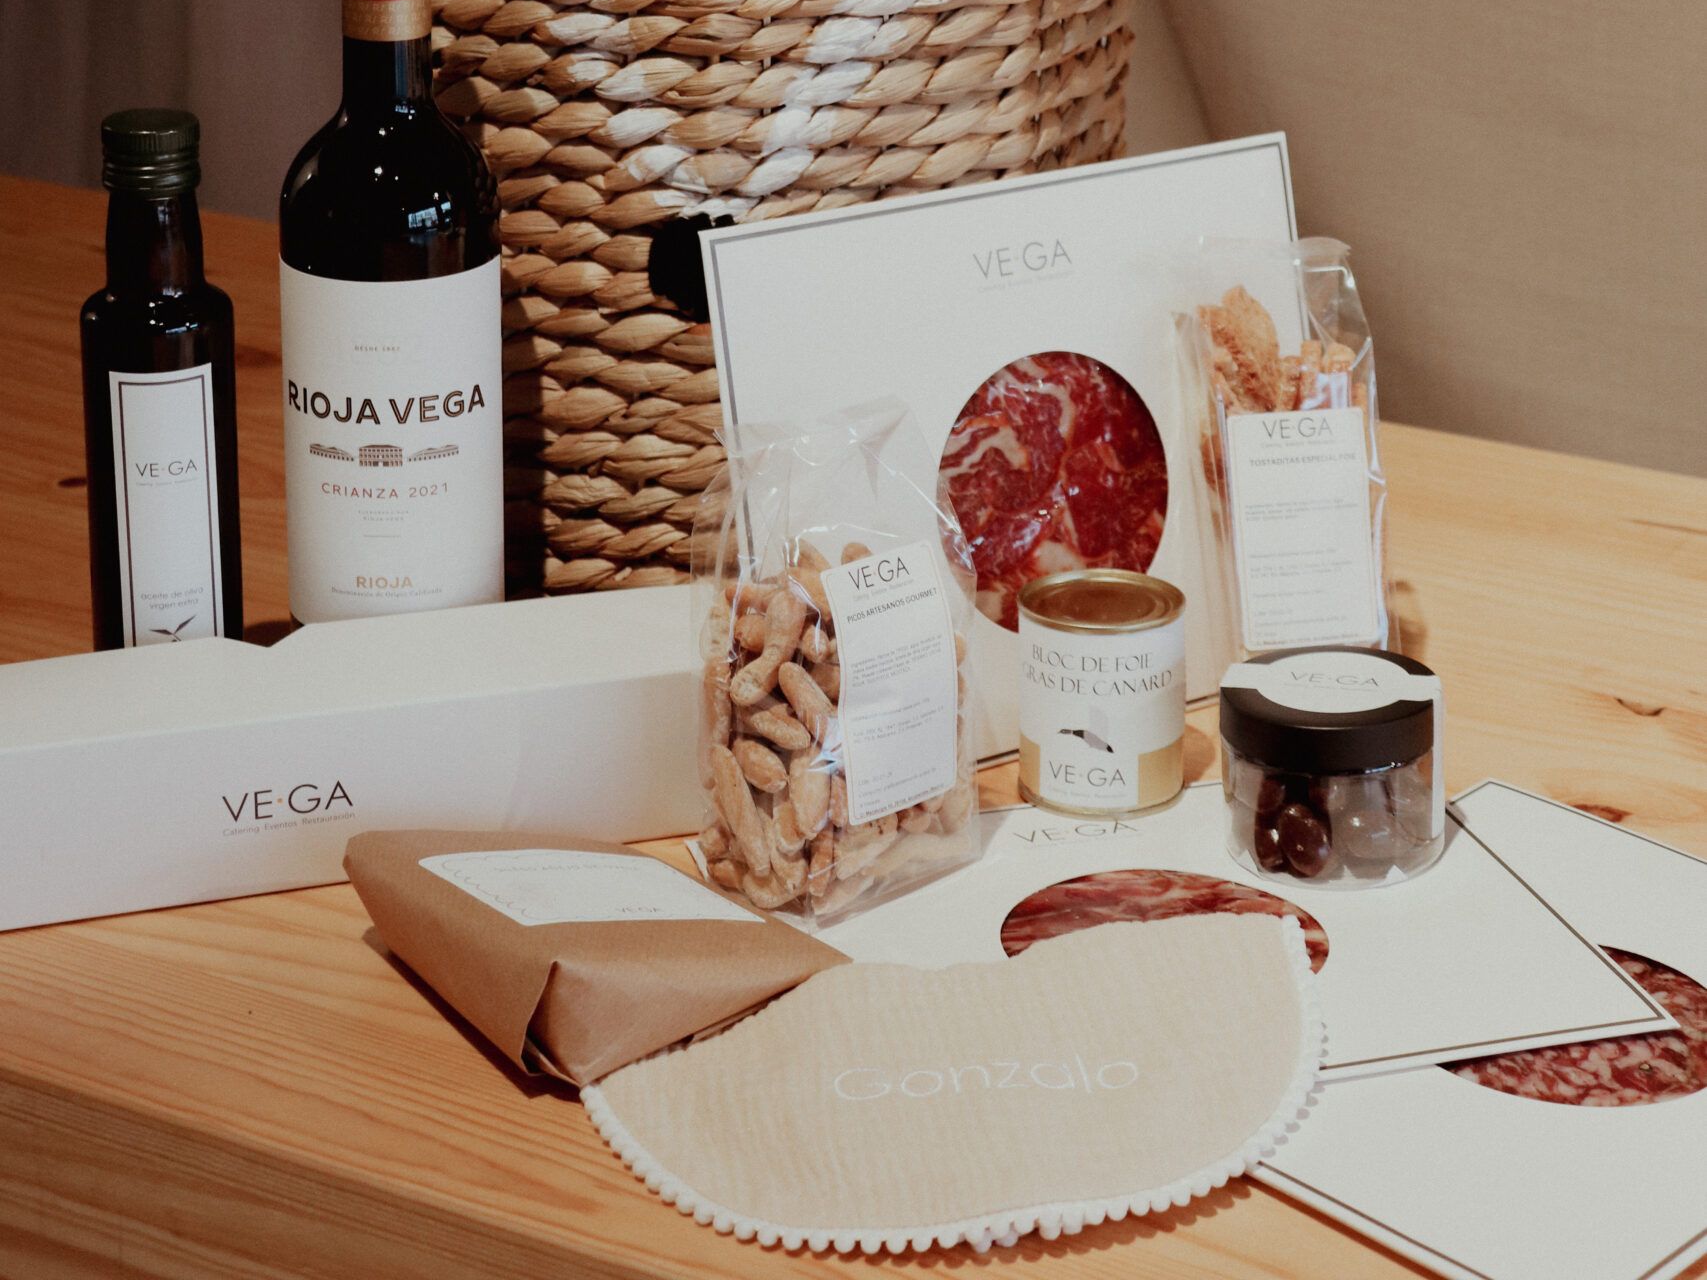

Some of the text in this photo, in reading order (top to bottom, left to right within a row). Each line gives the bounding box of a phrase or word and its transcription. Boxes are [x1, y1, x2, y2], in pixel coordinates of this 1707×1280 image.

[288, 378, 486, 425] RIOJA VEGA
[321, 482, 449, 500] CRIANZA 2021
[355, 575, 414, 589] RIOJA
[846, 613, 866, 625] PICOS
[866, 598, 906, 618] ARTESANOS
[906, 587, 938, 605] GOURMET
[1032, 643, 1153, 673] BLOC DE FOIE
[1060, 676, 1087, 694] DE
[1092, 669, 1173, 697] CANARD
[222, 811, 356, 838] Catering Eventos Restauración
[833, 1053, 1139, 1101] Gonzalo
